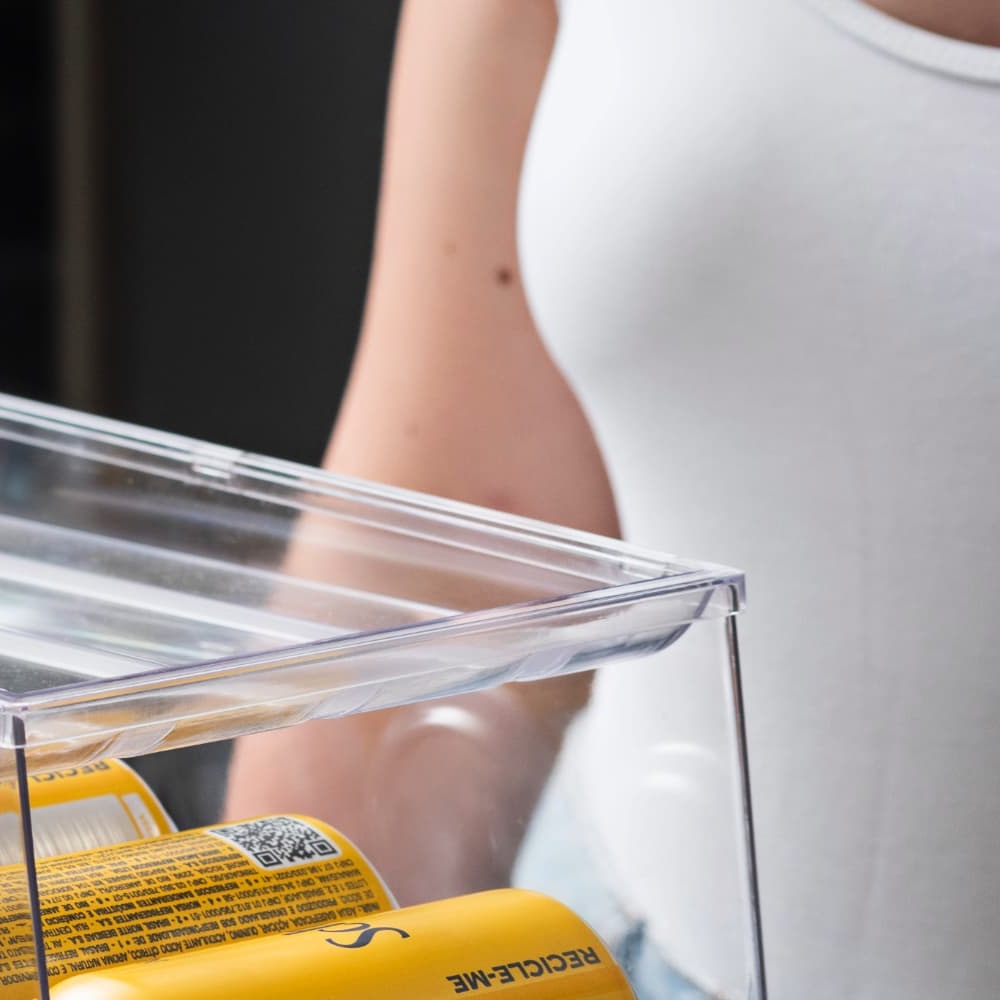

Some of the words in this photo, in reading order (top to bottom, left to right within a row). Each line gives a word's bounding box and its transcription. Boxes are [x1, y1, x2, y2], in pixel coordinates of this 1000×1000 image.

[192, 881, 240, 896] REFRESCOS
[43, 911, 86, 927] COMÉRCIO
[141, 918, 171, 929] BRASIL
[82, 928, 118, 941] BEBIDAS
[116, 923, 142, 935] NORTE
[146, 921, 219, 942] RESPONSABILIDADE
[77, 943, 111, 956] BRASAL
[127, 946, 159, 961] CÍTRICO,
[159, 942, 182, 954] ÁCIDO
[68, 957, 100, 972] NATURAL
[100, 951, 127, 965] AROMA
[447, 946, 600, 994] RECICLE-ME
